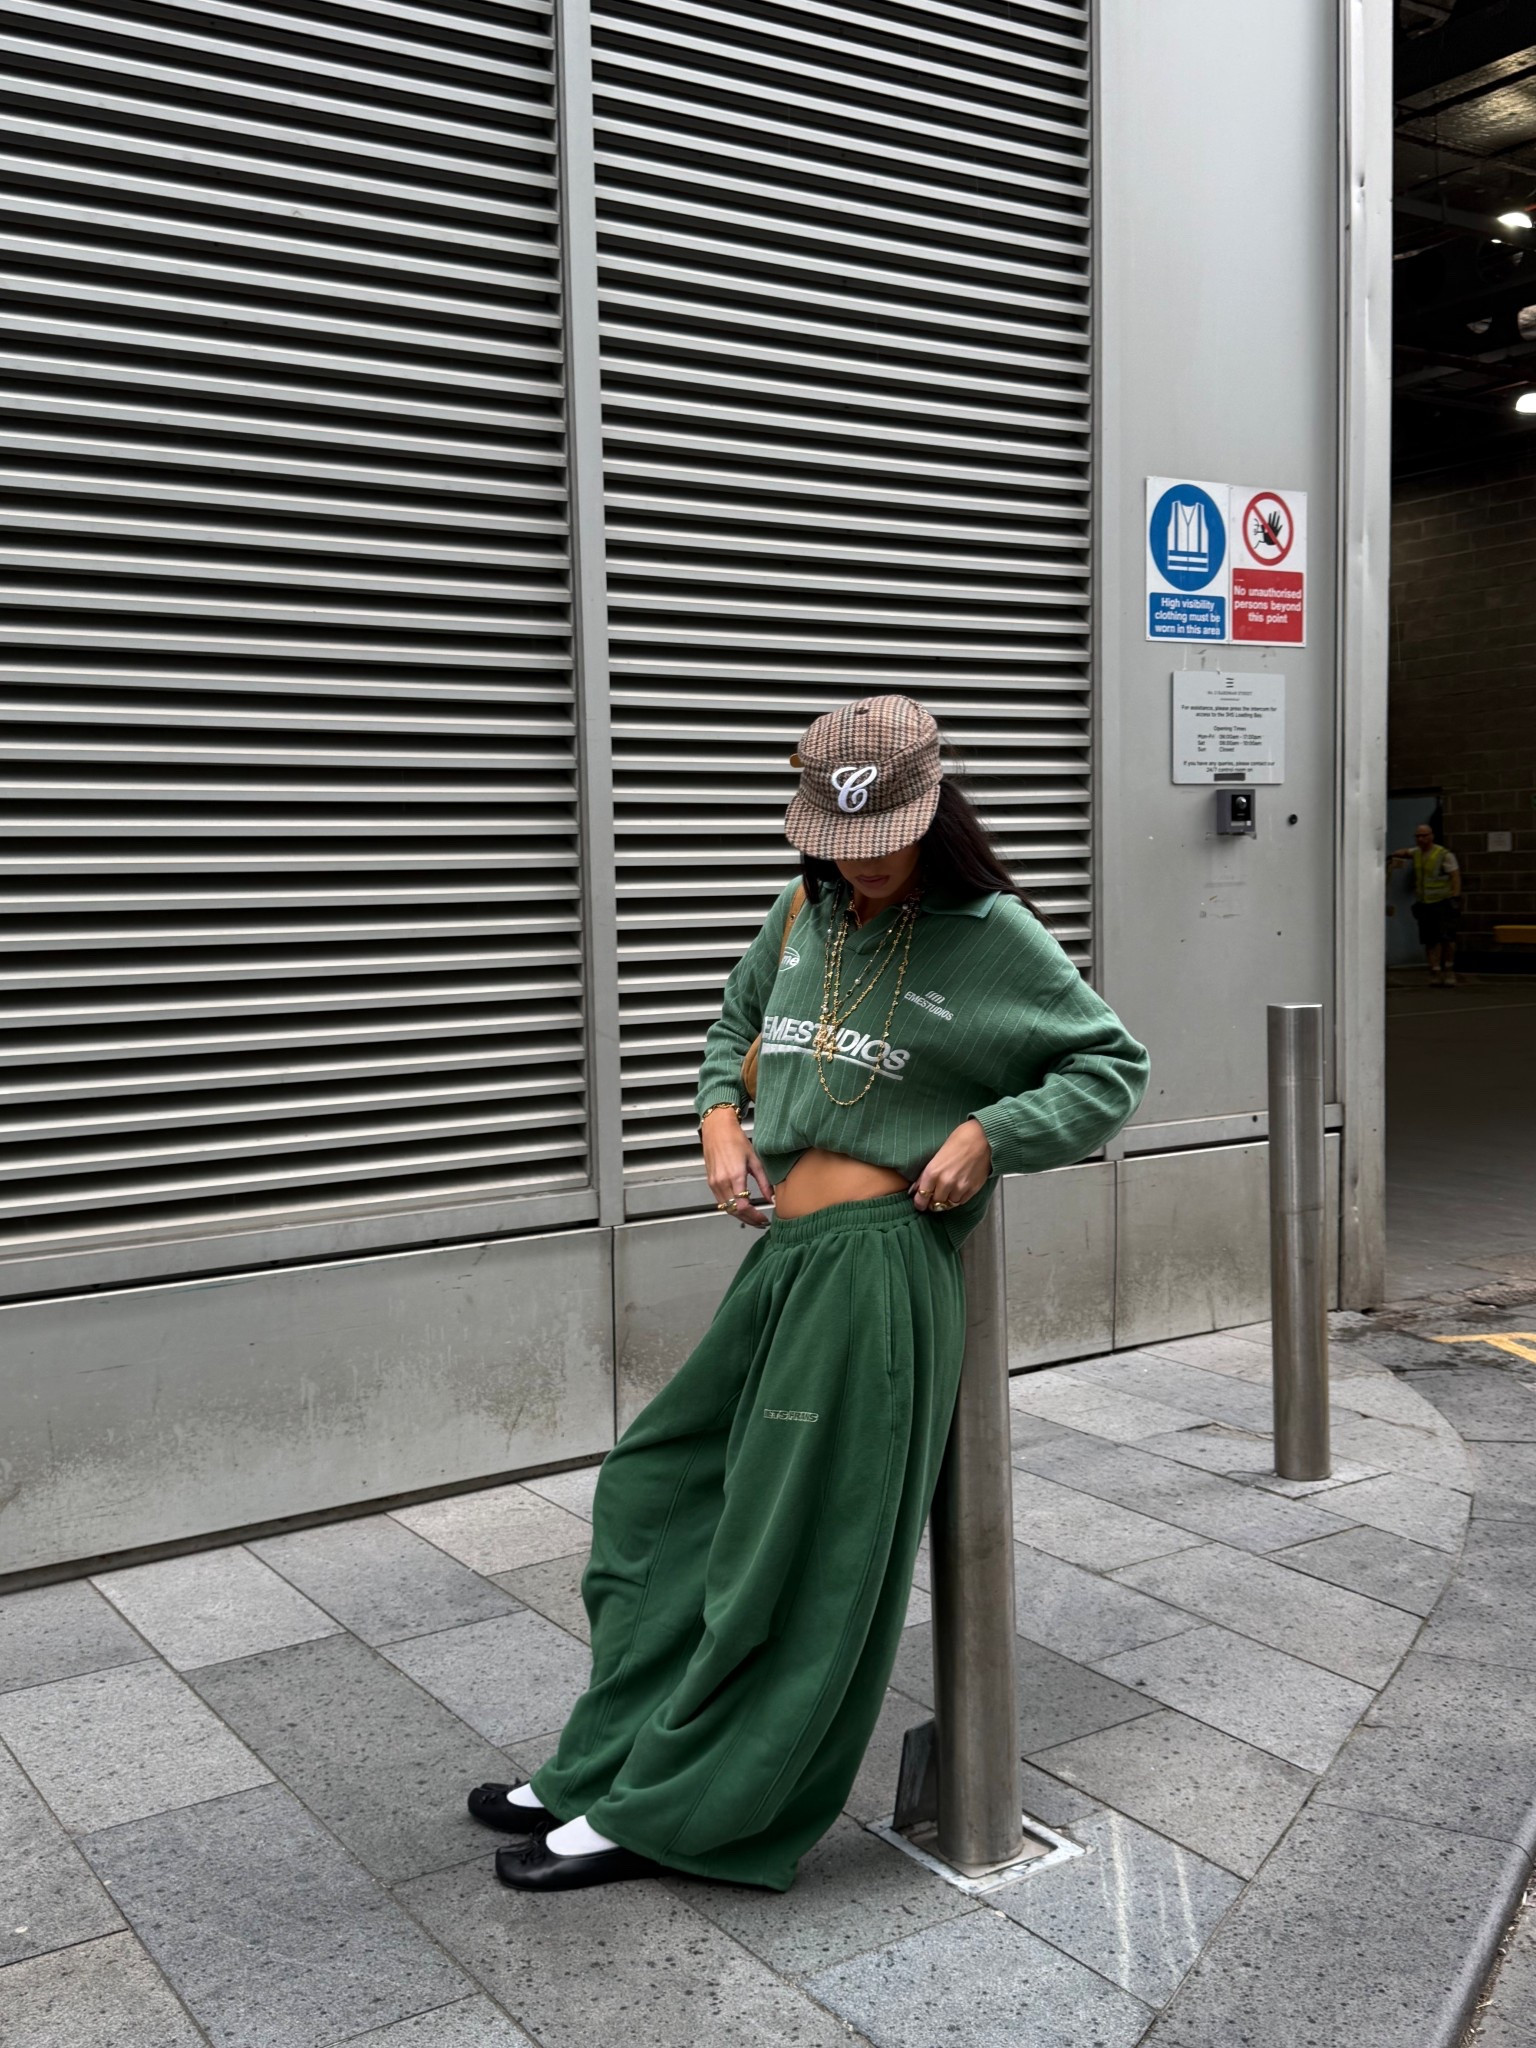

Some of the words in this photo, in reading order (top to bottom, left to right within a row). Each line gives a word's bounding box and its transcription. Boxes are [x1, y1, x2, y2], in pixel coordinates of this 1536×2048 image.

[1234, 586, 1246, 596] No
[1248, 587, 1302, 599] unauthorised
[1161, 597, 1180, 609] High
[1182, 599, 1215, 612] visibility
[1234, 600, 1268, 610] persons
[1270, 600, 1302, 612] beyond
[1155, 610, 1187, 623] clothing
[1189, 613, 1209, 622] must
[1210, 613, 1221, 622] be
[1248, 612, 1264, 622] this
[1266, 613, 1288, 624] point
[1155, 625, 1175, 633] worn
[1177, 624, 1185, 633] in
[1186, 624, 1201, 634] this
[1203, 627, 1221, 635] area
[831, 766, 878, 813] C
[904, 990, 954, 1021] EMESTUDIOS
